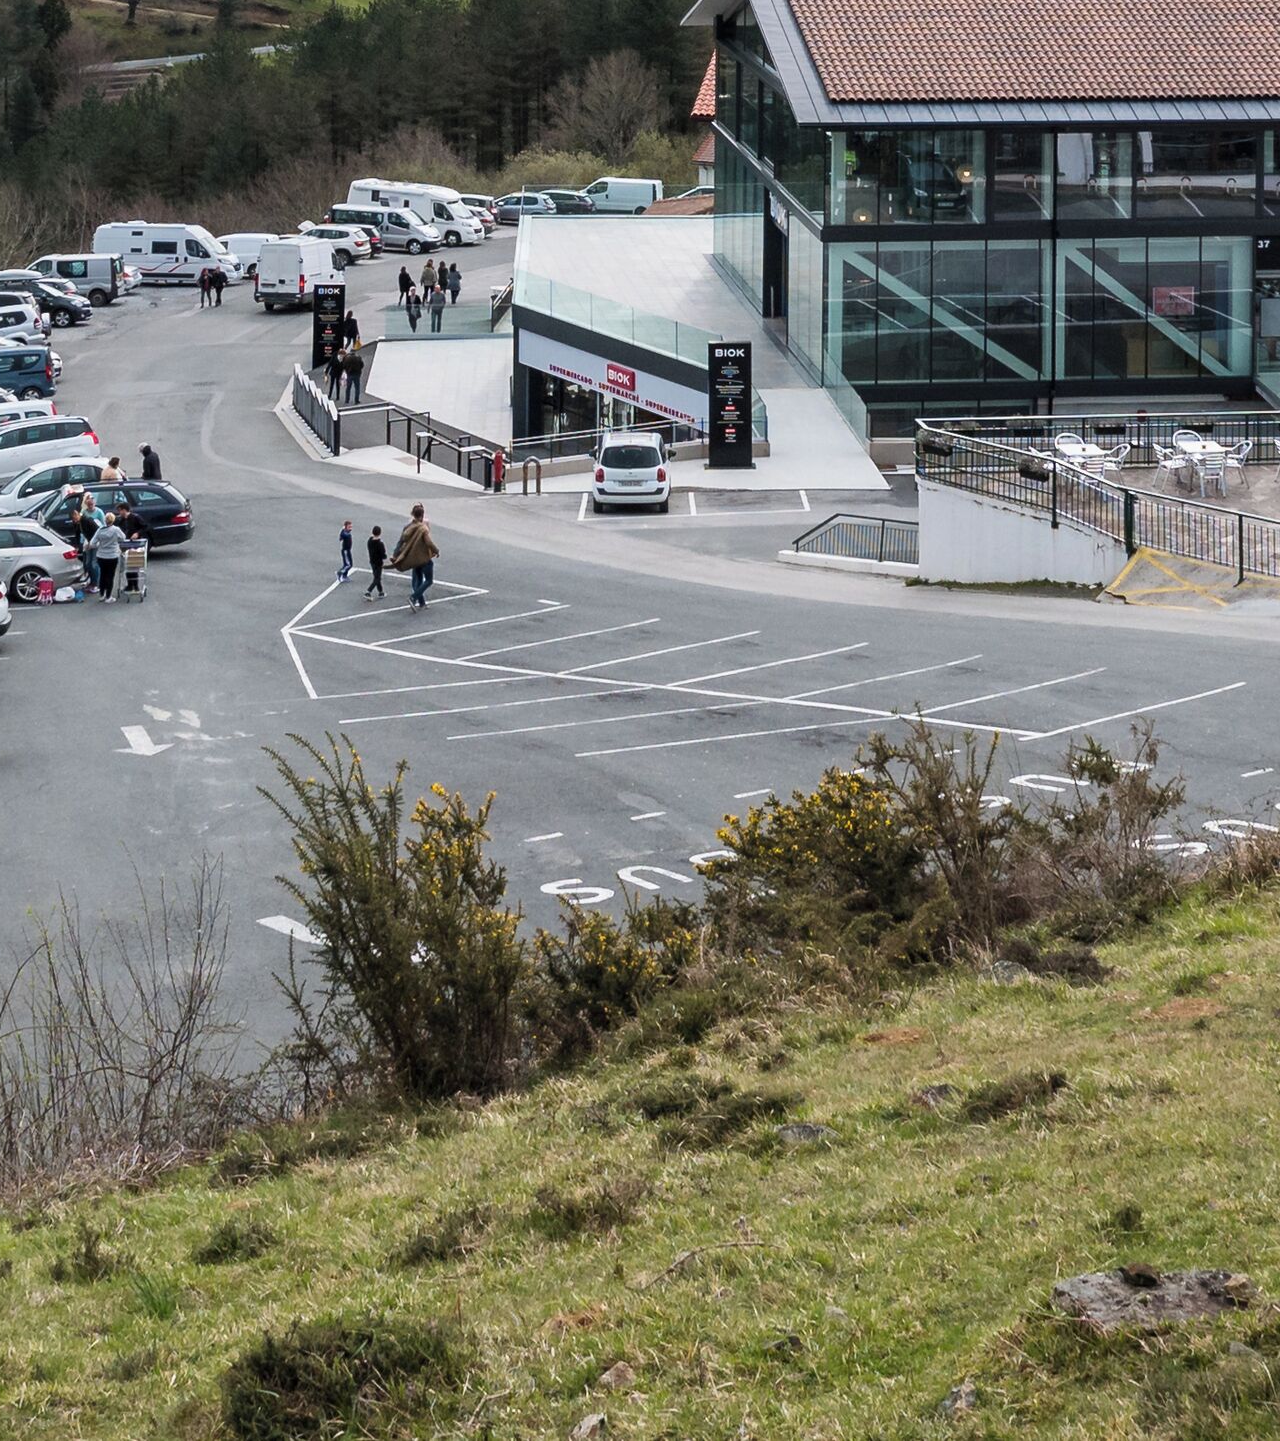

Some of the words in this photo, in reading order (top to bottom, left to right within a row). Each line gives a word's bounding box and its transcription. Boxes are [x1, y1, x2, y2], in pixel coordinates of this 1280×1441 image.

[1257, 240, 1270, 249] 37
[318, 287, 340, 295] BIOK
[714, 348, 745, 357] BIOK
[607, 369, 631, 386] BIOK
[549, 363, 593, 386] SUPERMERCADO
[598, 381, 640, 404] SUPERMARCHÉ
